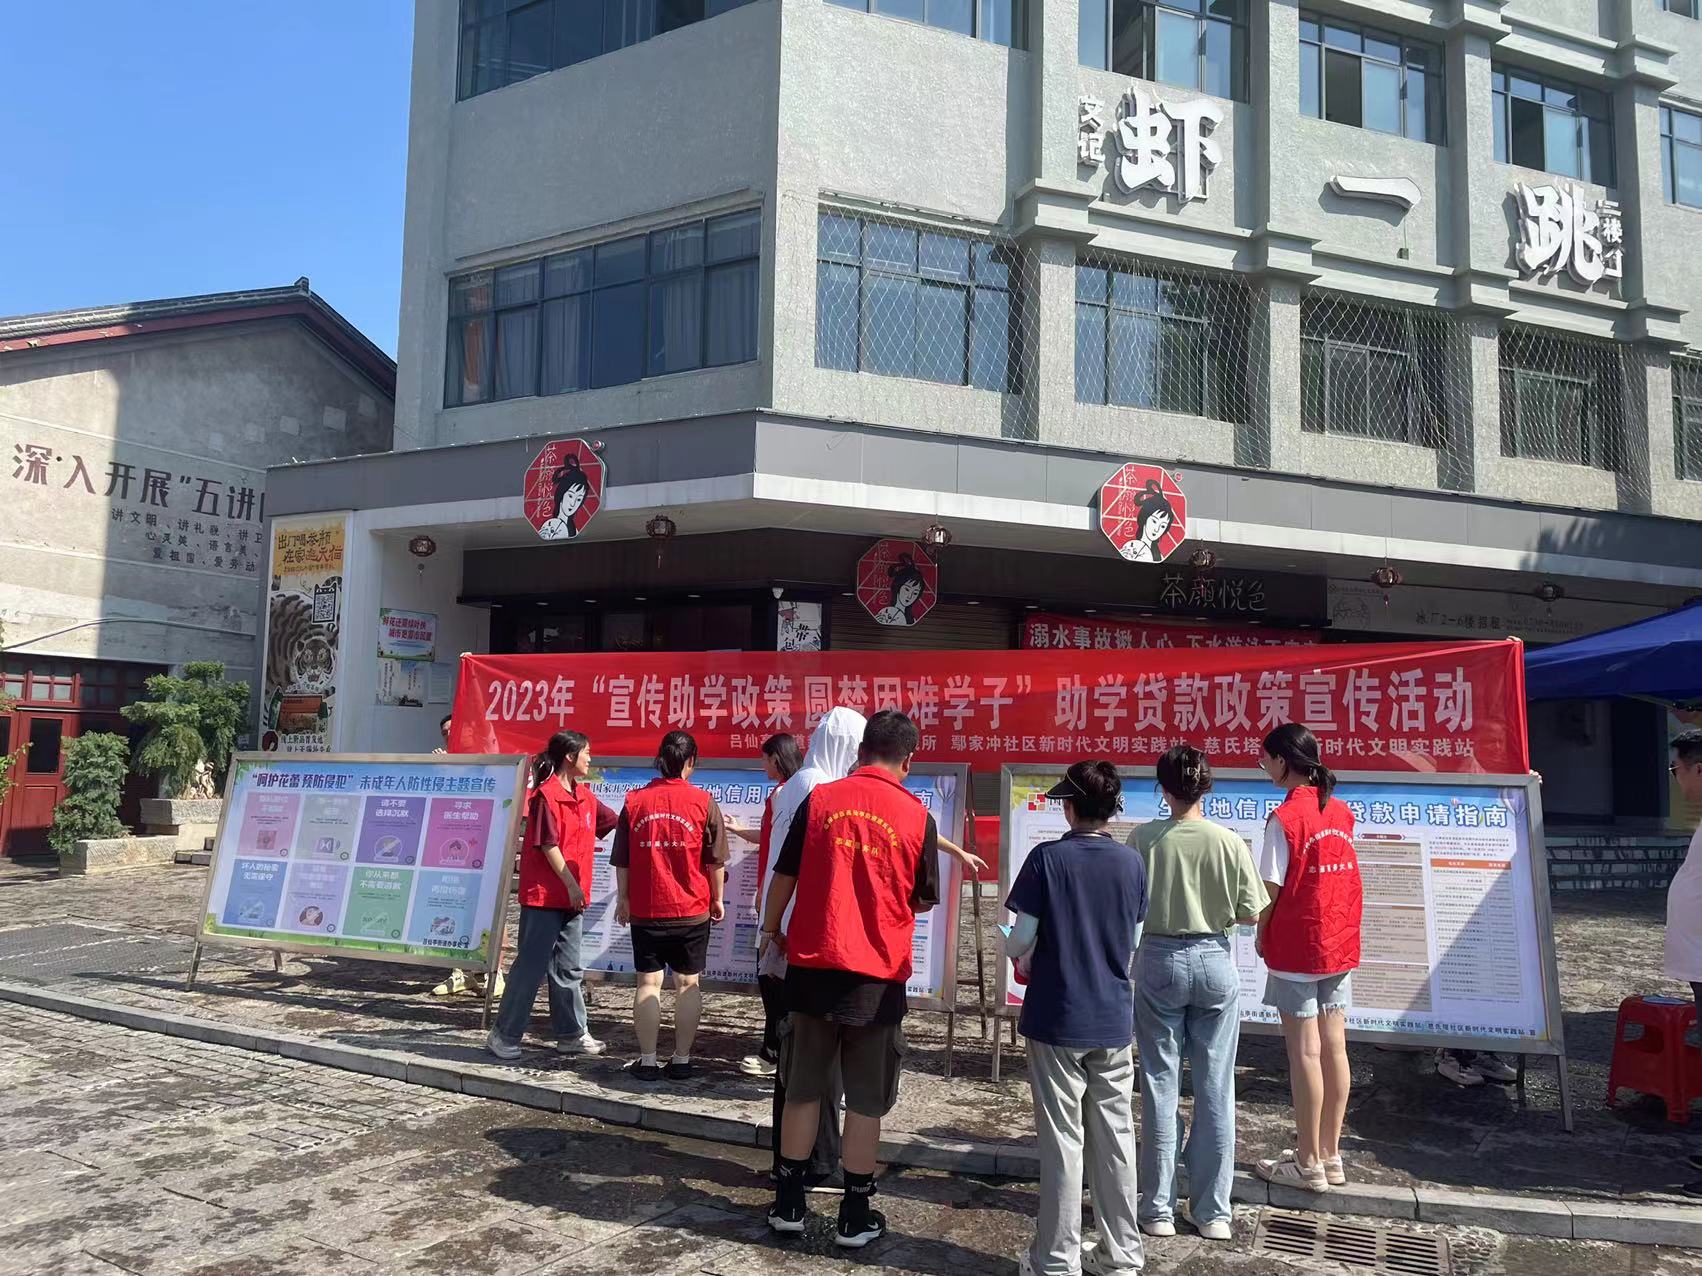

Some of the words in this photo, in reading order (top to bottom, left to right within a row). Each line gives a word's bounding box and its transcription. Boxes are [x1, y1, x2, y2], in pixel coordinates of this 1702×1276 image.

[12, 443, 265, 523] 深入开展“五讲
[485, 675, 576, 727] 2023年
[1055, 667, 1474, 732] 助学贷款政策宣传活动
[360, 775, 497, 794] 未成年人防性侵主题宣传
